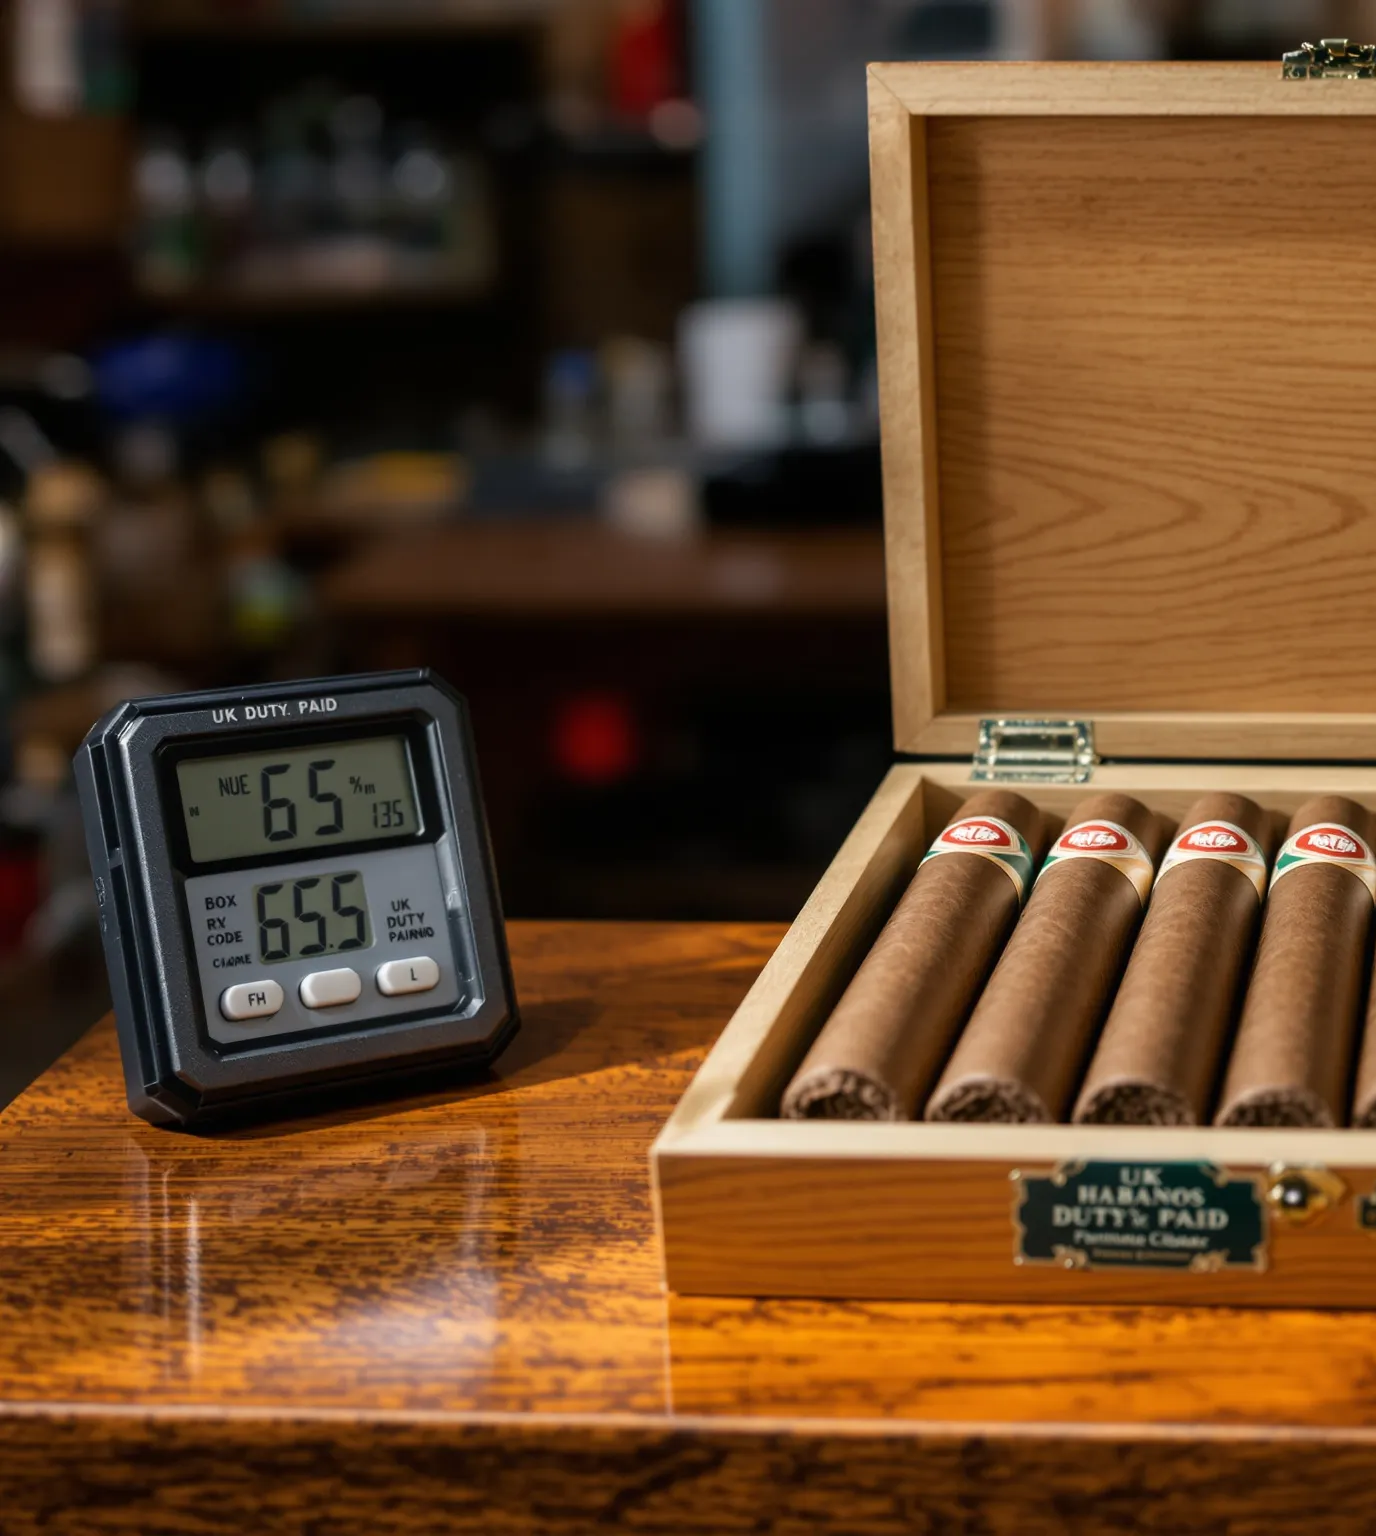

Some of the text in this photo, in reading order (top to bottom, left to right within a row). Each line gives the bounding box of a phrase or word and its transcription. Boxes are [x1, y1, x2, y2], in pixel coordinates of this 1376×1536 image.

[212, 708, 238, 724] UK
[298, 698, 338, 714] PAID
[218, 774, 251, 797] NUE
[260, 759, 345, 842] 65
[372, 800, 405, 829] 135
[204, 895, 238, 911] BOX
[391, 898, 411, 913] UK
[207, 917, 227, 931] RX
[256, 872, 367, 961] 65.5
[386, 912, 426, 929] DUTY
[206, 931, 244, 947] CODE
[409, 967, 418, 981] L
[247, 992, 267, 1007] FH
[1120, 1167, 1163, 1186] UK
[1076, 1184, 1206, 1208] HABANOS
[1157, 1207, 1230, 1230] PAID
